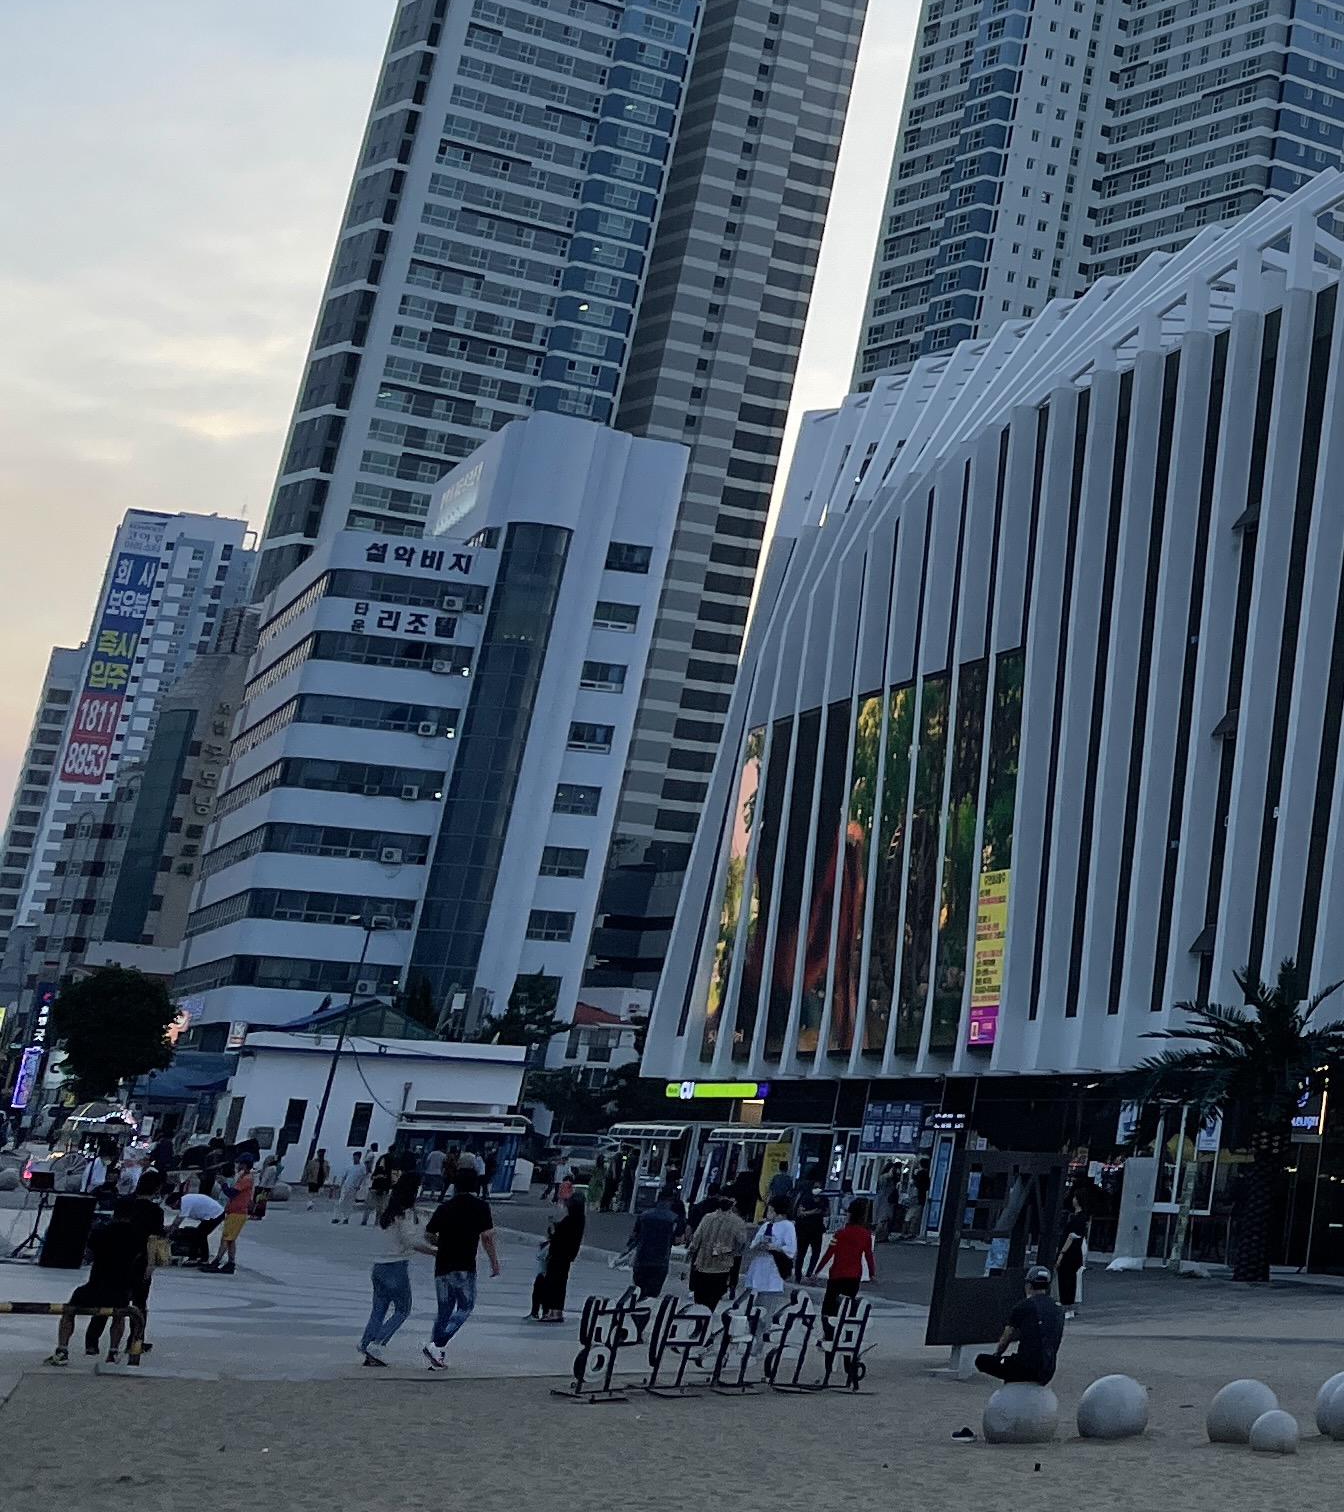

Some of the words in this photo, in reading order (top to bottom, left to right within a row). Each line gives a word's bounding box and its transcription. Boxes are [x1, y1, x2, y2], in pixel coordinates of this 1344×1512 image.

[105, 588, 150, 619] 보유분
[97, 629, 138, 660] 즉시
[88, 660, 130, 690] 입주
[77, 698, 118, 734] 1811
[64, 741, 108, 778] 8853
